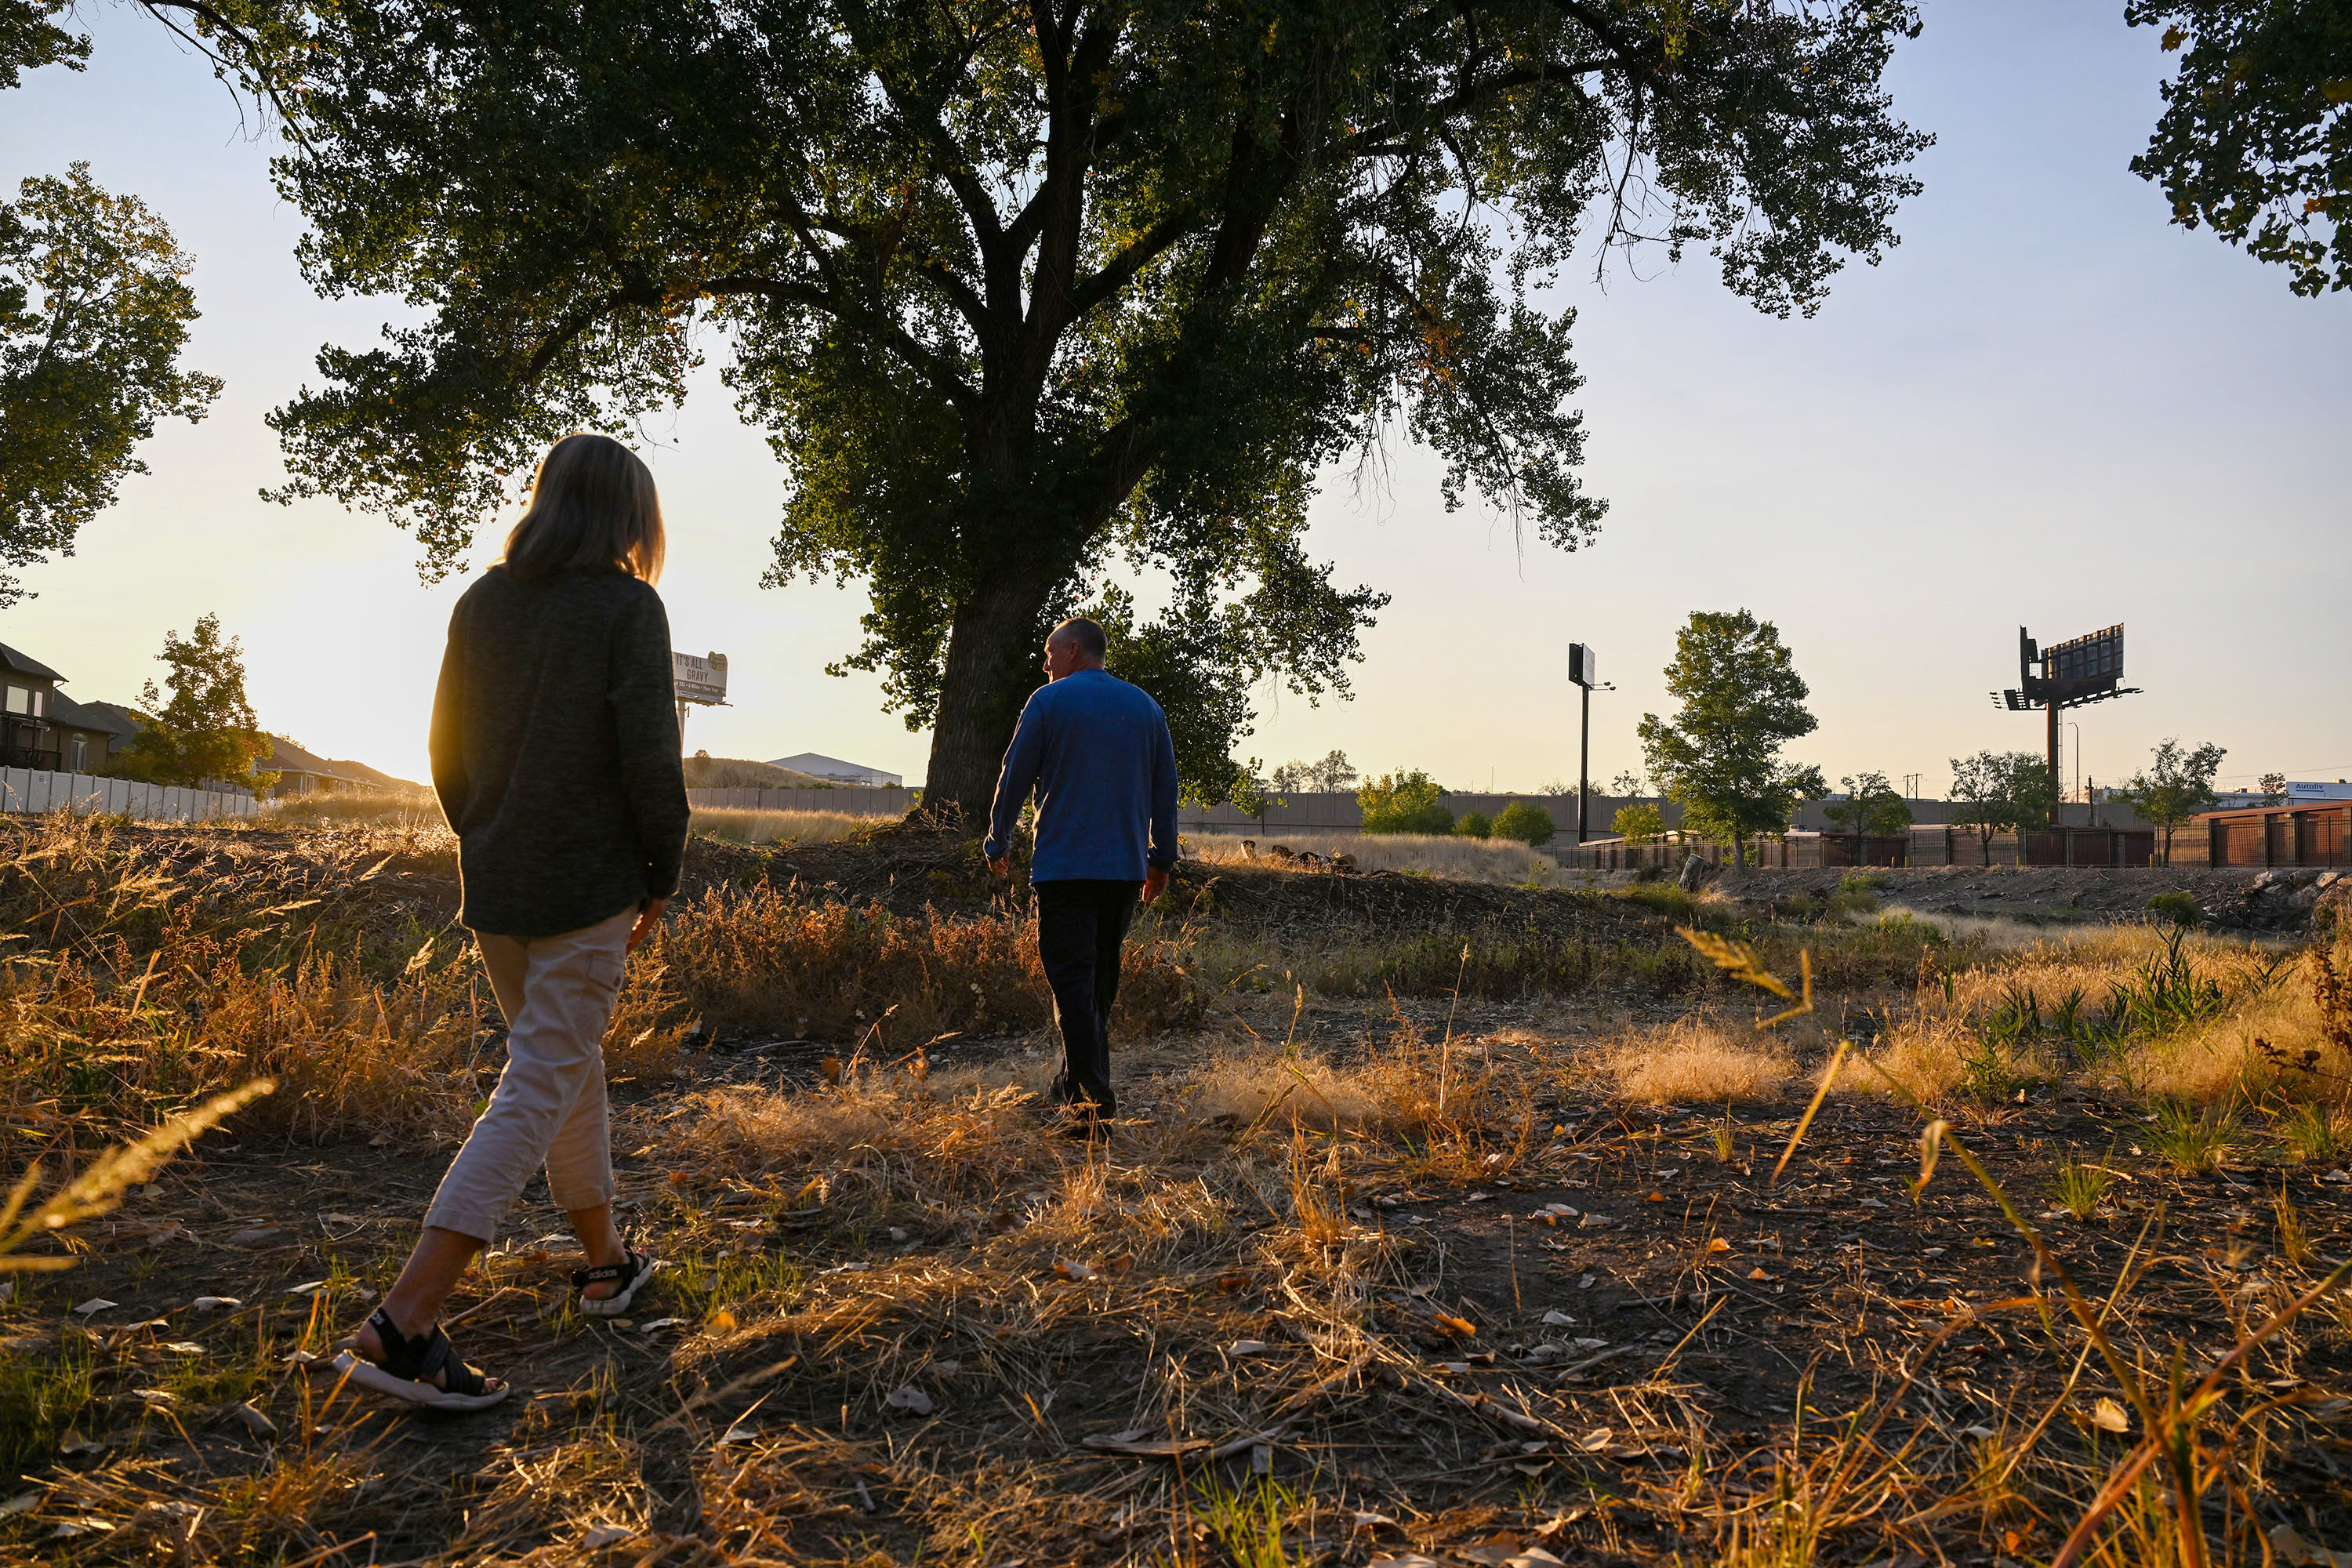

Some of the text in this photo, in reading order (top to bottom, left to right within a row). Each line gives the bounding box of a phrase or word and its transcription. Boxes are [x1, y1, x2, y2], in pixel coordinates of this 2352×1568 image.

[677, 654, 690, 666] IT'S
[691, 658, 703, 670] ALL
[687, 669, 709, 683] GRAVY
[588, 1269, 618, 1279] adidas
